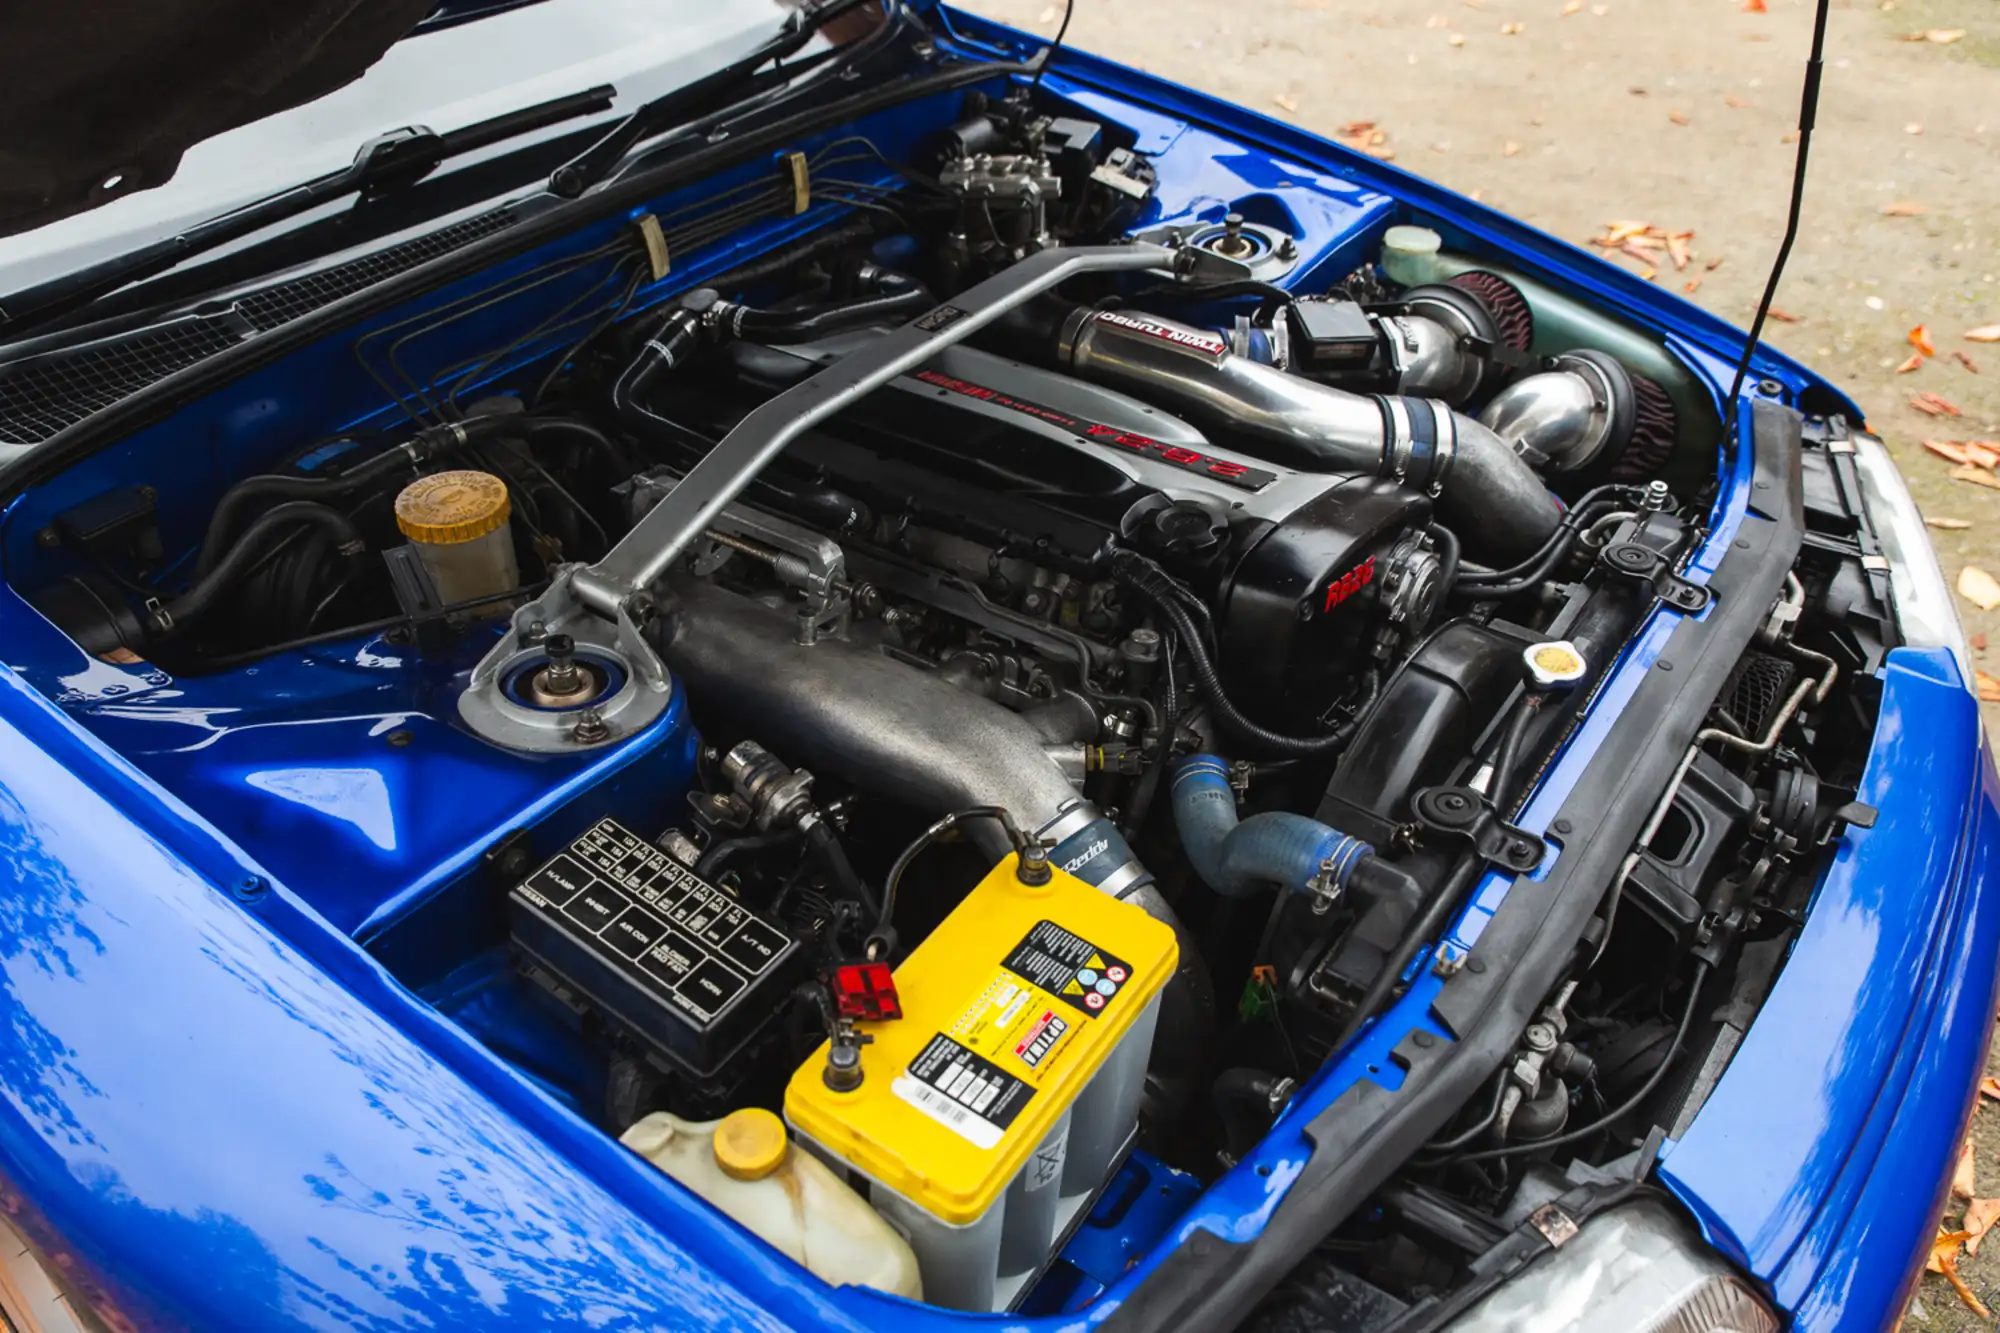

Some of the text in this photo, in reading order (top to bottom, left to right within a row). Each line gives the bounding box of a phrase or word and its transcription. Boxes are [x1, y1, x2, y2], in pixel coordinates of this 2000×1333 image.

[1100, 311, 1218, 352] TWIN TURBO
[1324, 554, 1377, 613] RB26
[1061, 839, 1108, 874] Reddy
[546, 870, 575, 891] H/LAMP
[517, 884, 547, 908] NISSAN
[619, 922, 650, 944] AIR CON
[741, 934, 759, 947] A/T
[650, 949, 684, 975] RAD FAN
[660, 944, 690, 966] BLOWER
[699, 978, 722, 996] HORN
[1023, 1018, 1066, 1065] OPTIMA
